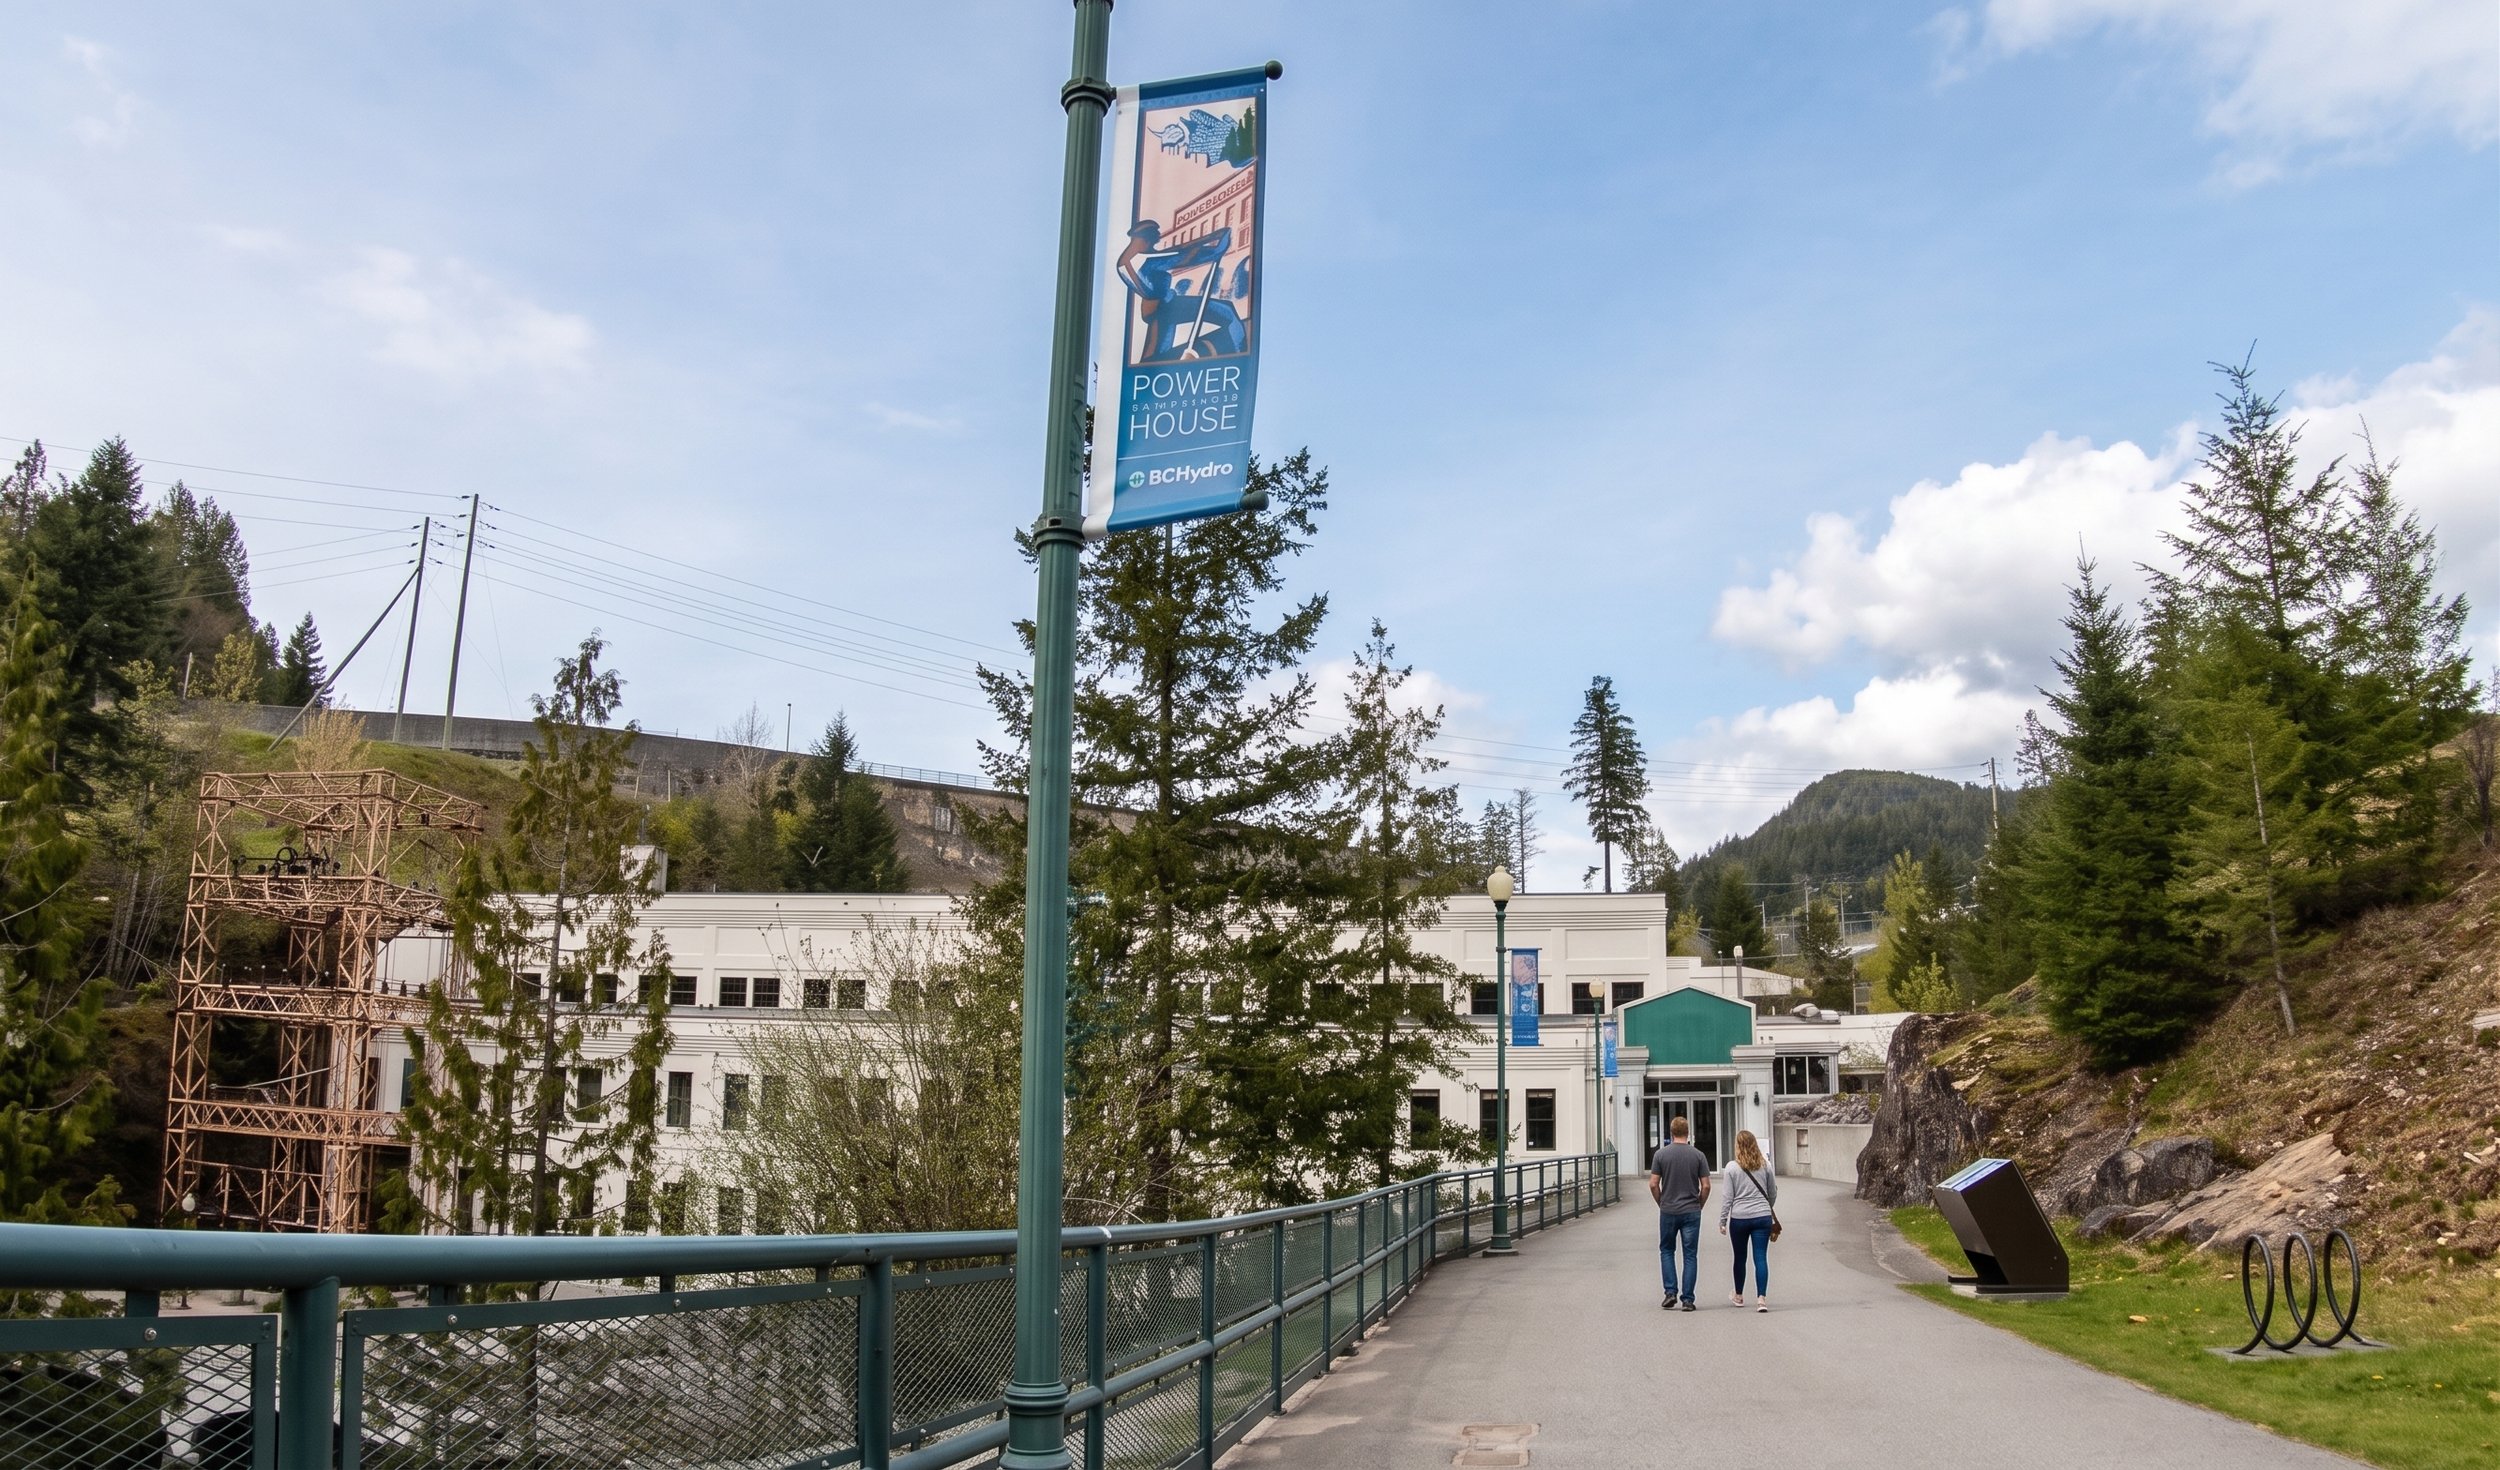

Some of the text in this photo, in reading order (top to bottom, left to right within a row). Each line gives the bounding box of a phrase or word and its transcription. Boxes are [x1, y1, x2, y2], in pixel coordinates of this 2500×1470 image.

[1133, 366, 1241, 400] POWER
[1130, 404, 1238, 440] HOUSE
[1149, 462, 1233, 485] BCHydro
